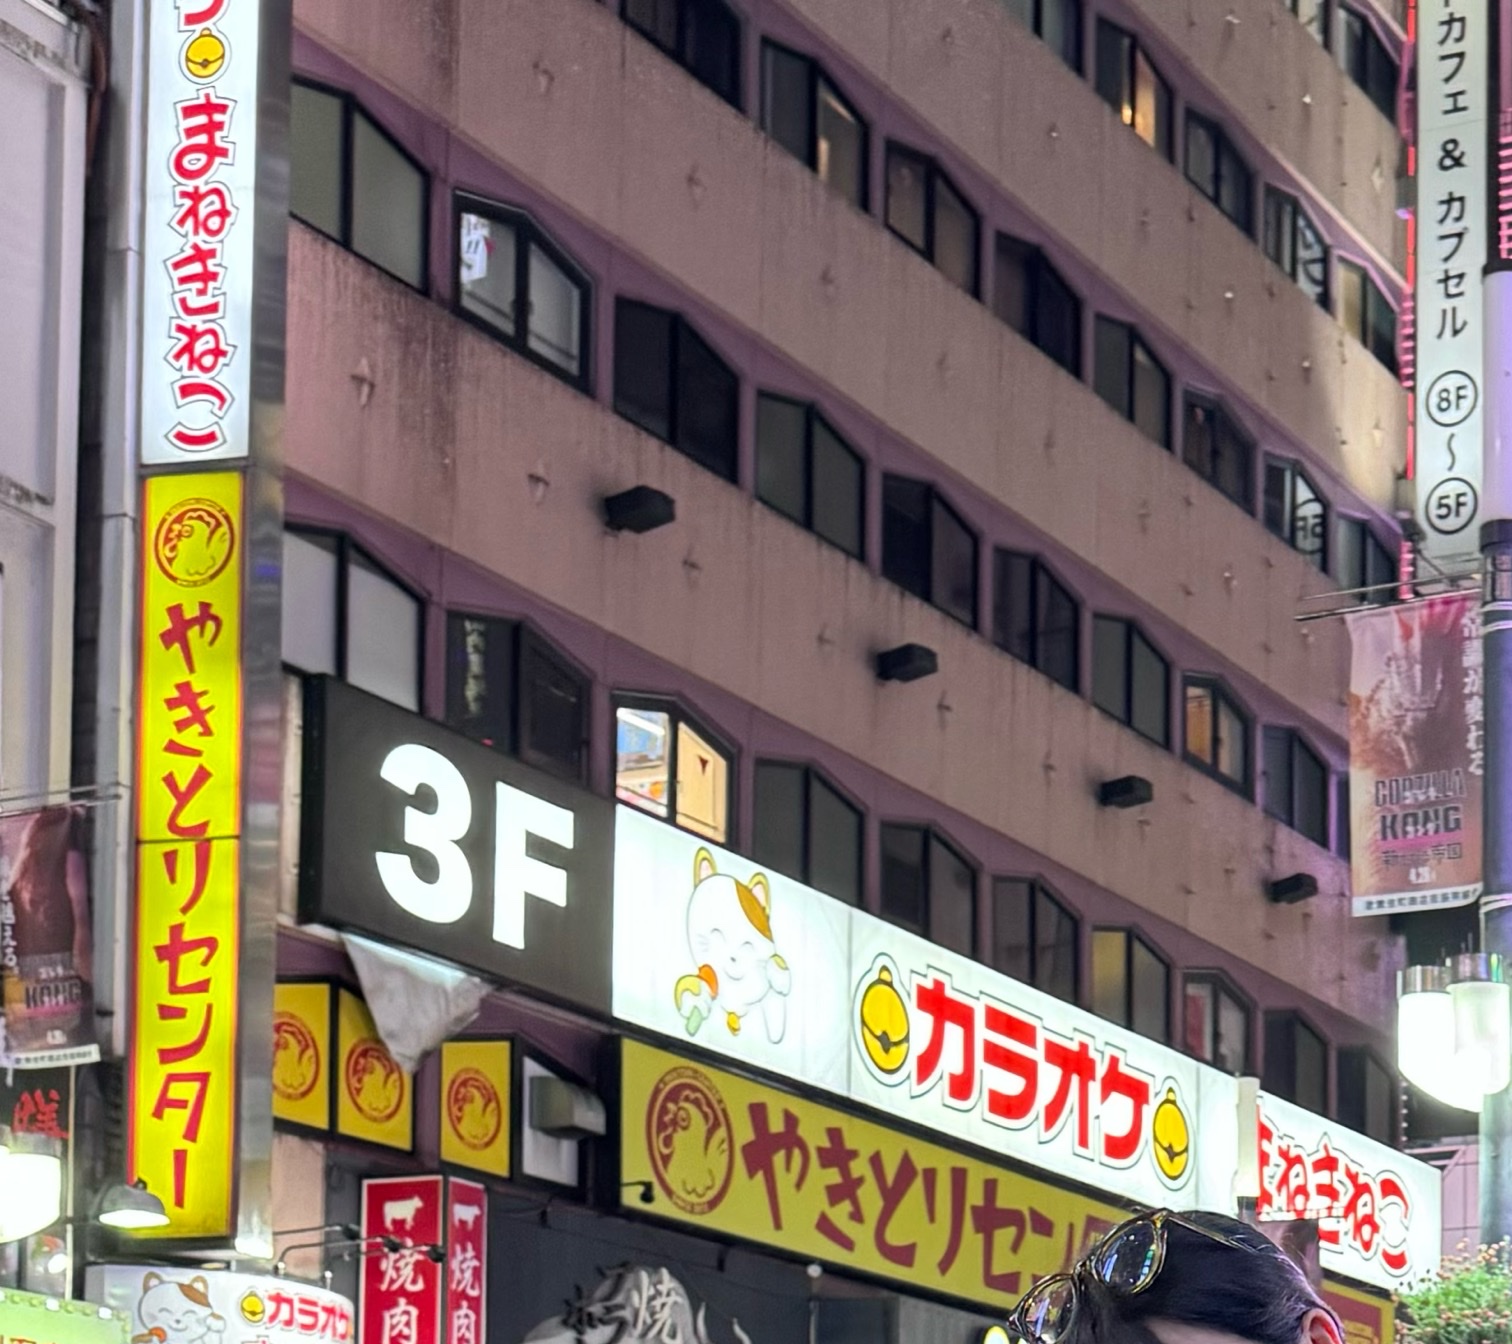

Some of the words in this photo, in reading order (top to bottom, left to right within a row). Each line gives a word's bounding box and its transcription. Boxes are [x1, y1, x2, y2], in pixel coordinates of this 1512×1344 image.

[1436, 0, 1468, 114] カフェ
[1438, 138, 1466, 171] &
[170, 92, 234, 448] まねきねこ
[1436, 386, 1468, 412] 8F
[1436, 494, 1468, 519] 5F
[376, 743, 574, 949] 3F
[1380, 804, 1462, 841] KONG
[152, 601, 222, 1208] やきとりセンター
[914, 977, 1152, 1160] カラオケ
[741, 1101, 1112, 1293] やきとりセン
